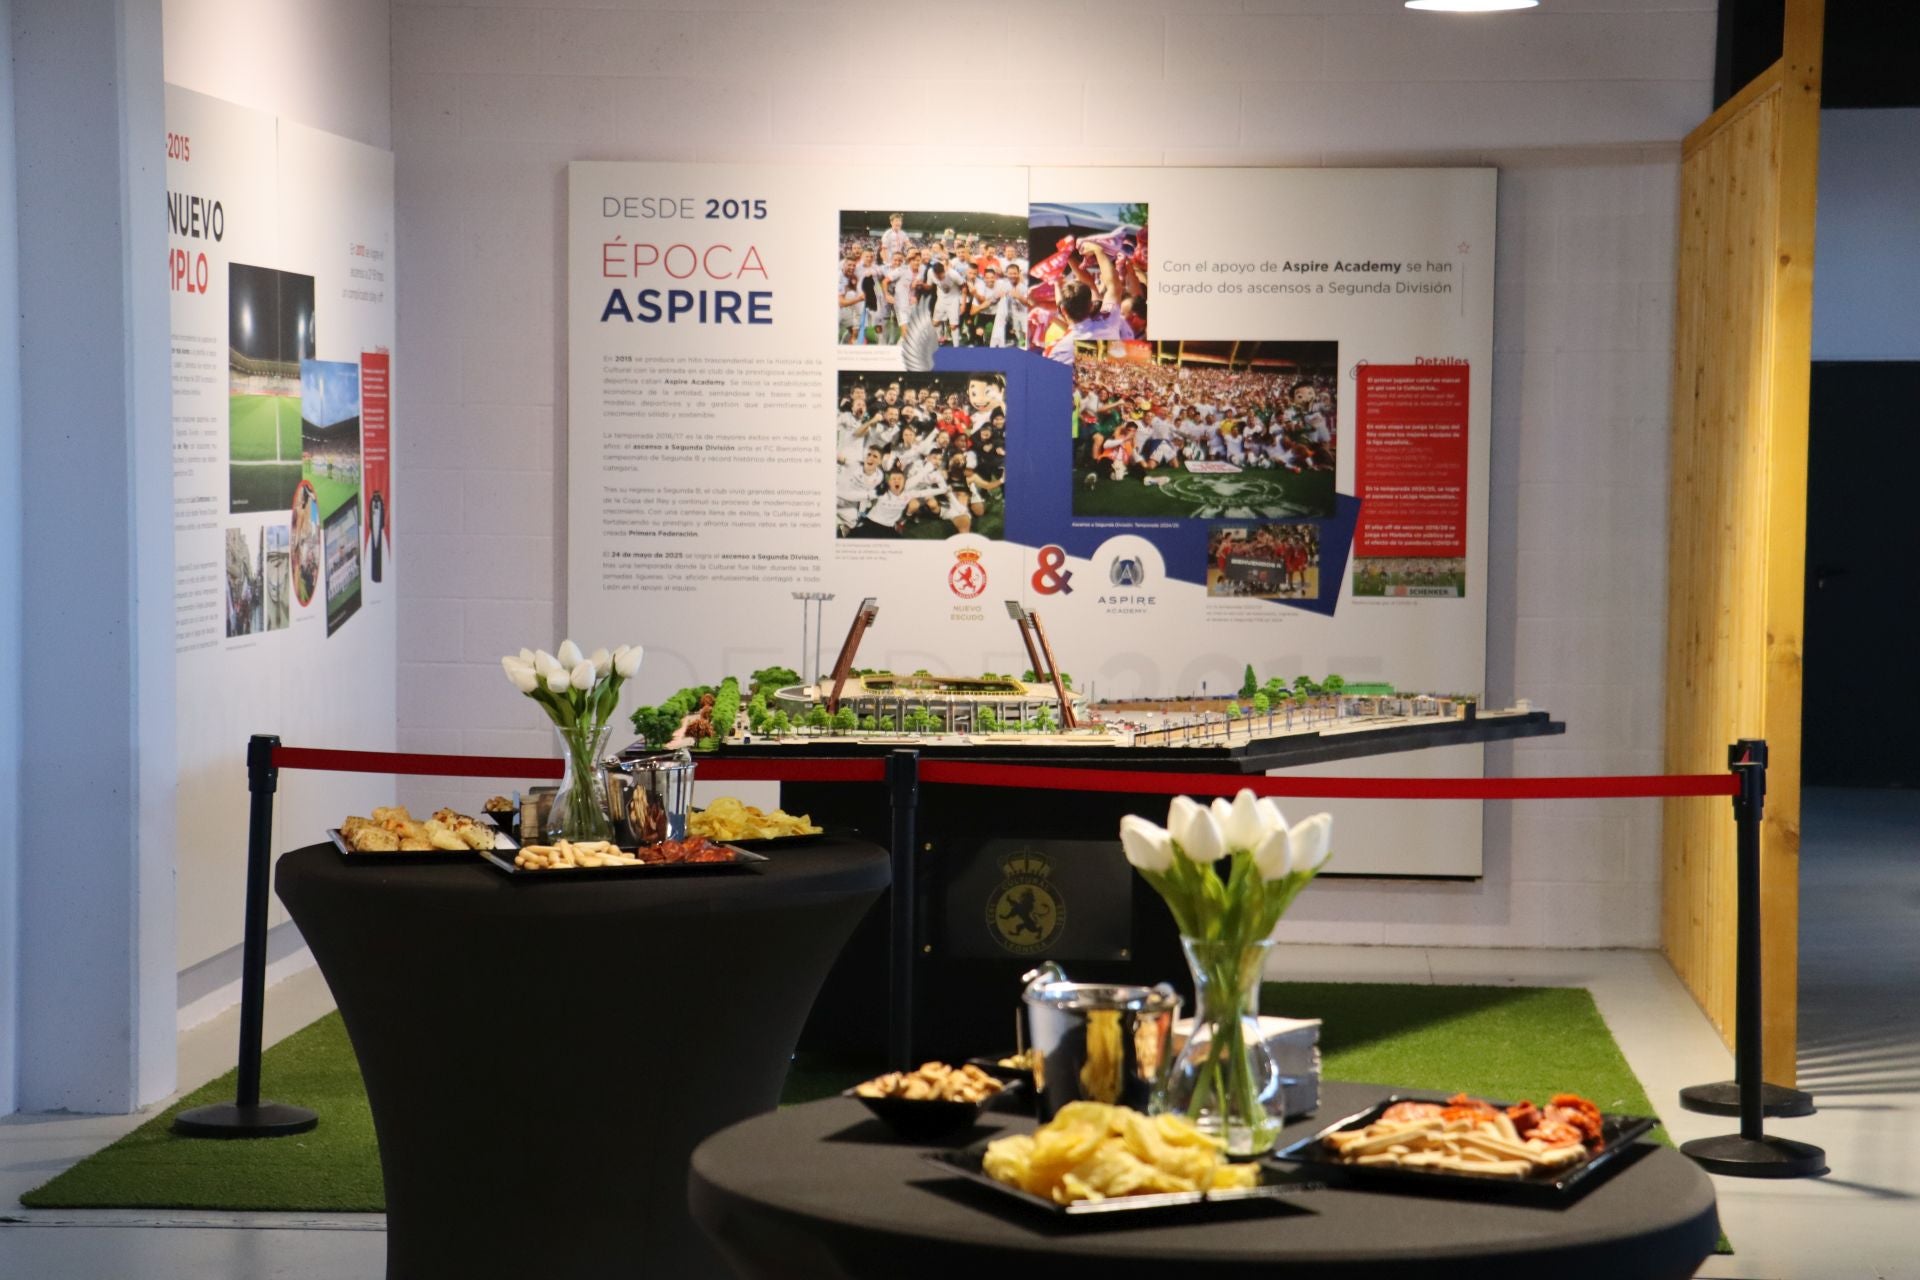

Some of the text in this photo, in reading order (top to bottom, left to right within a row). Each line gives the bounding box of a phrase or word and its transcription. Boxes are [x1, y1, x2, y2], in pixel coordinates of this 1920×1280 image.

[603, 197, 767, 219] DESDE 2015
[167, 191, 224, 242] NUEVO
[603, 235, 769, 280] ÉPOCA
[1163, 261, 1452, 276] Con el apoyo de Aspire Academy se han
[1158, 282, 1451, 297] logrado dos ascensos a Segunda División
[600, 288, 773, 324] ASPIRE
[663, 378, 688, 387] Aspire
[670, 443, 703, 453] Segunda
[664, 551, 683, 559] 2025
[757, 553, 788, 562] Segunda
[1031, 545, 1074, 595] &
[1098, 595, 1157, 606] ASPIRE
